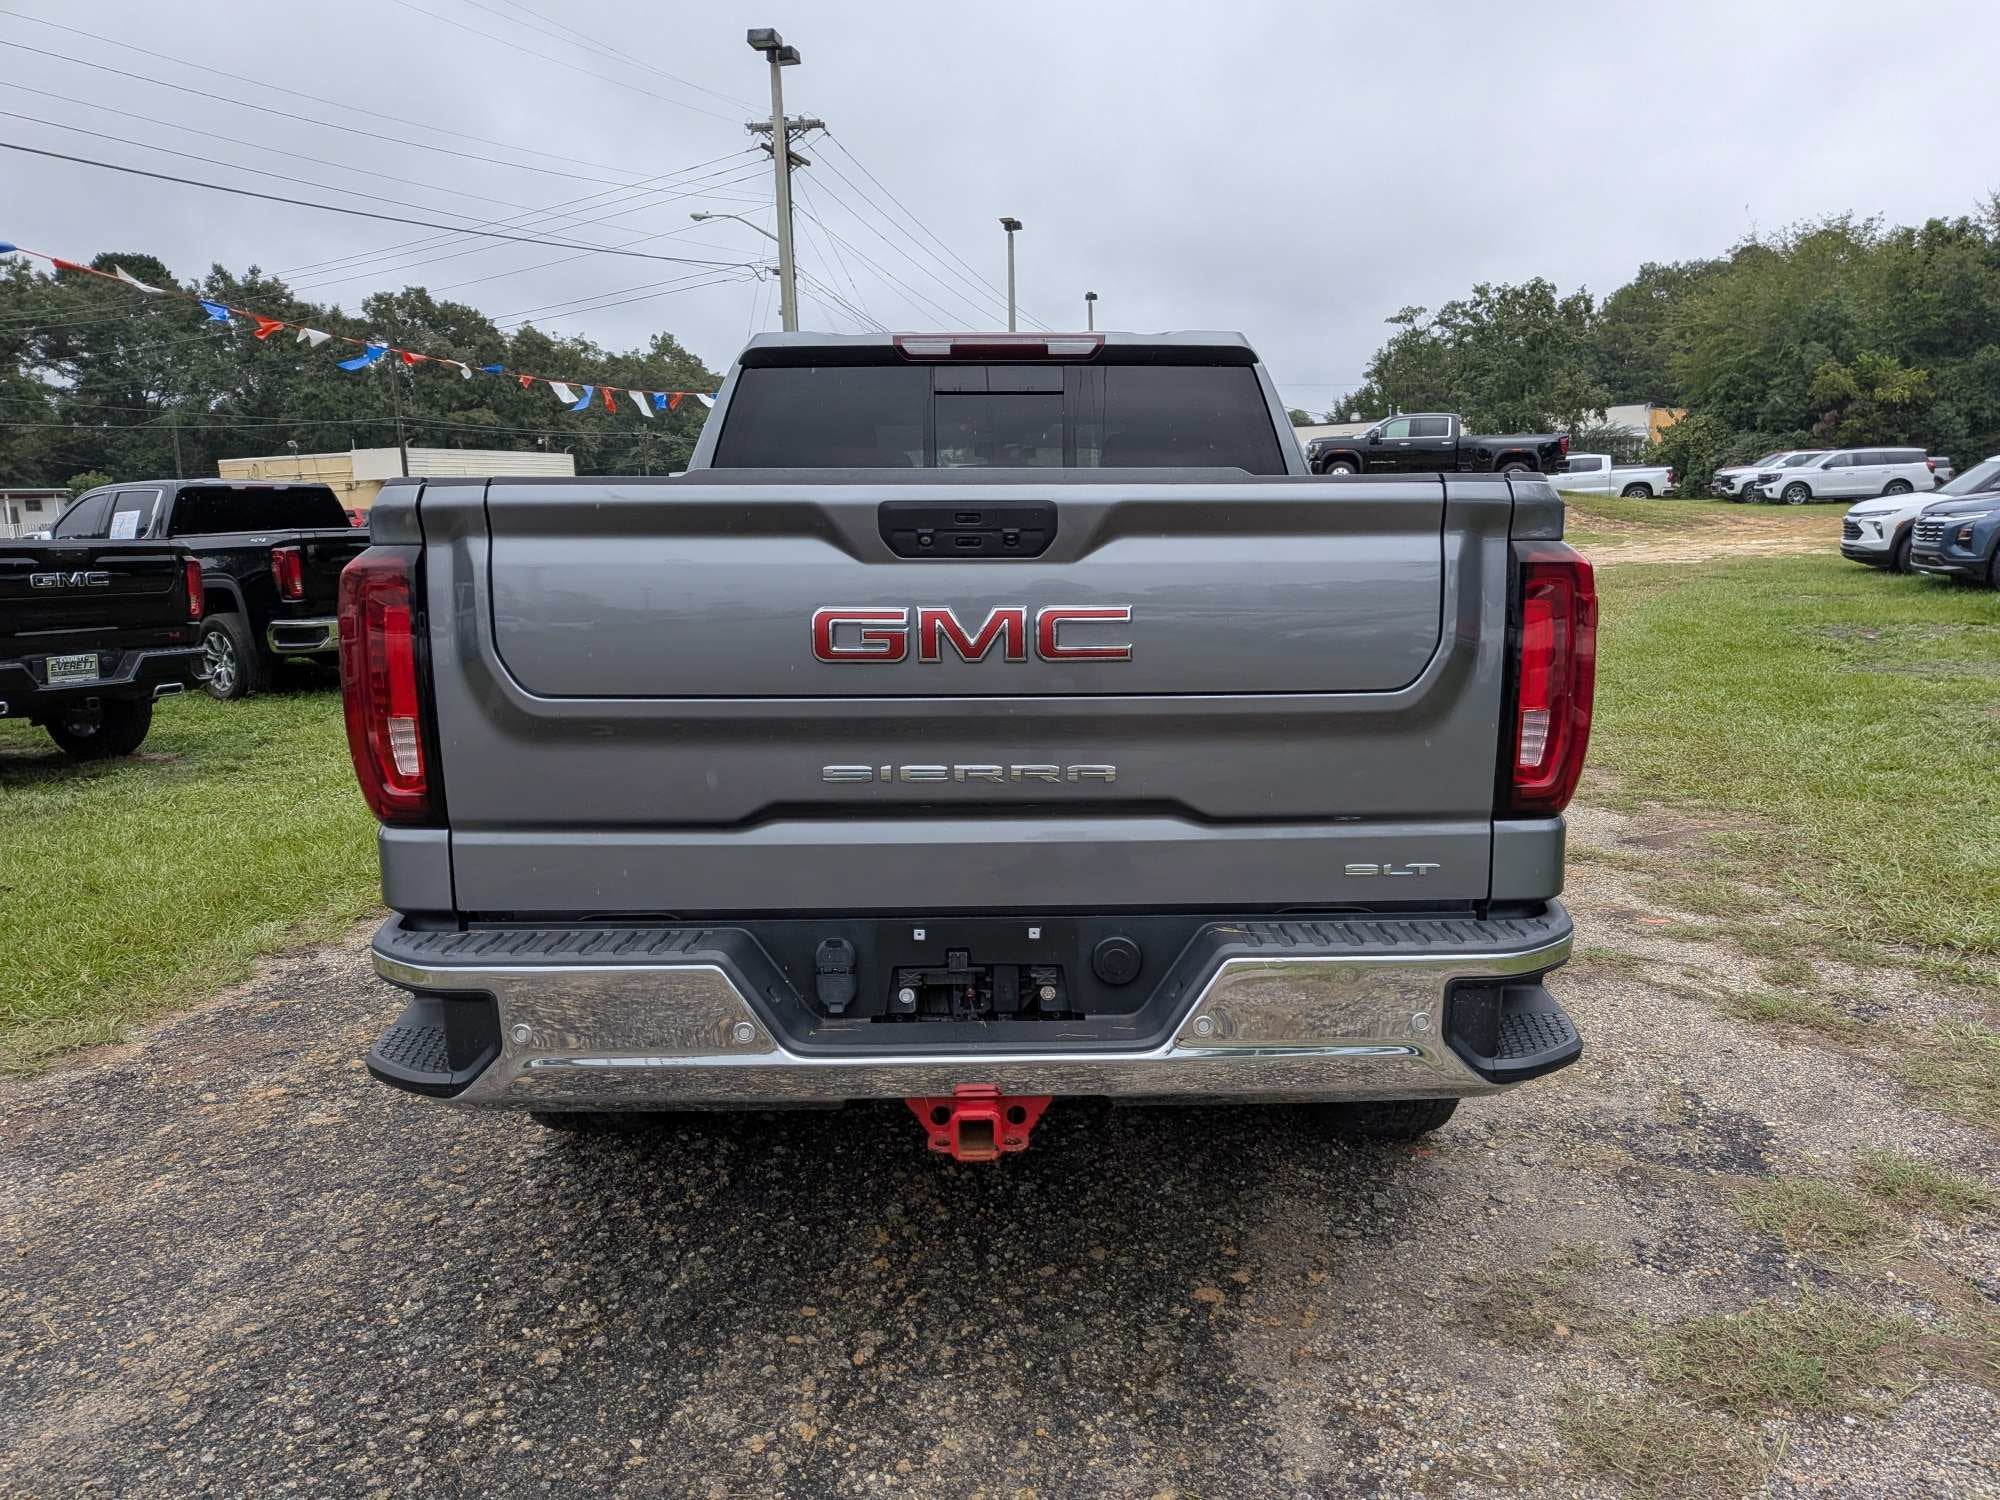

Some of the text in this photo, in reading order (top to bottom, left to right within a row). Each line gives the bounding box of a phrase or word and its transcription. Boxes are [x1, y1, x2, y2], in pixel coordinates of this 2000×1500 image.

[30, 571, 109, 588] GMC
[812, 604, 1132, 663] GMC
[50, 660, 95, 671] EVERETT
[822, 765, 1117, 783] SIERRA
[1344, 863, 1441, 876] SLT
